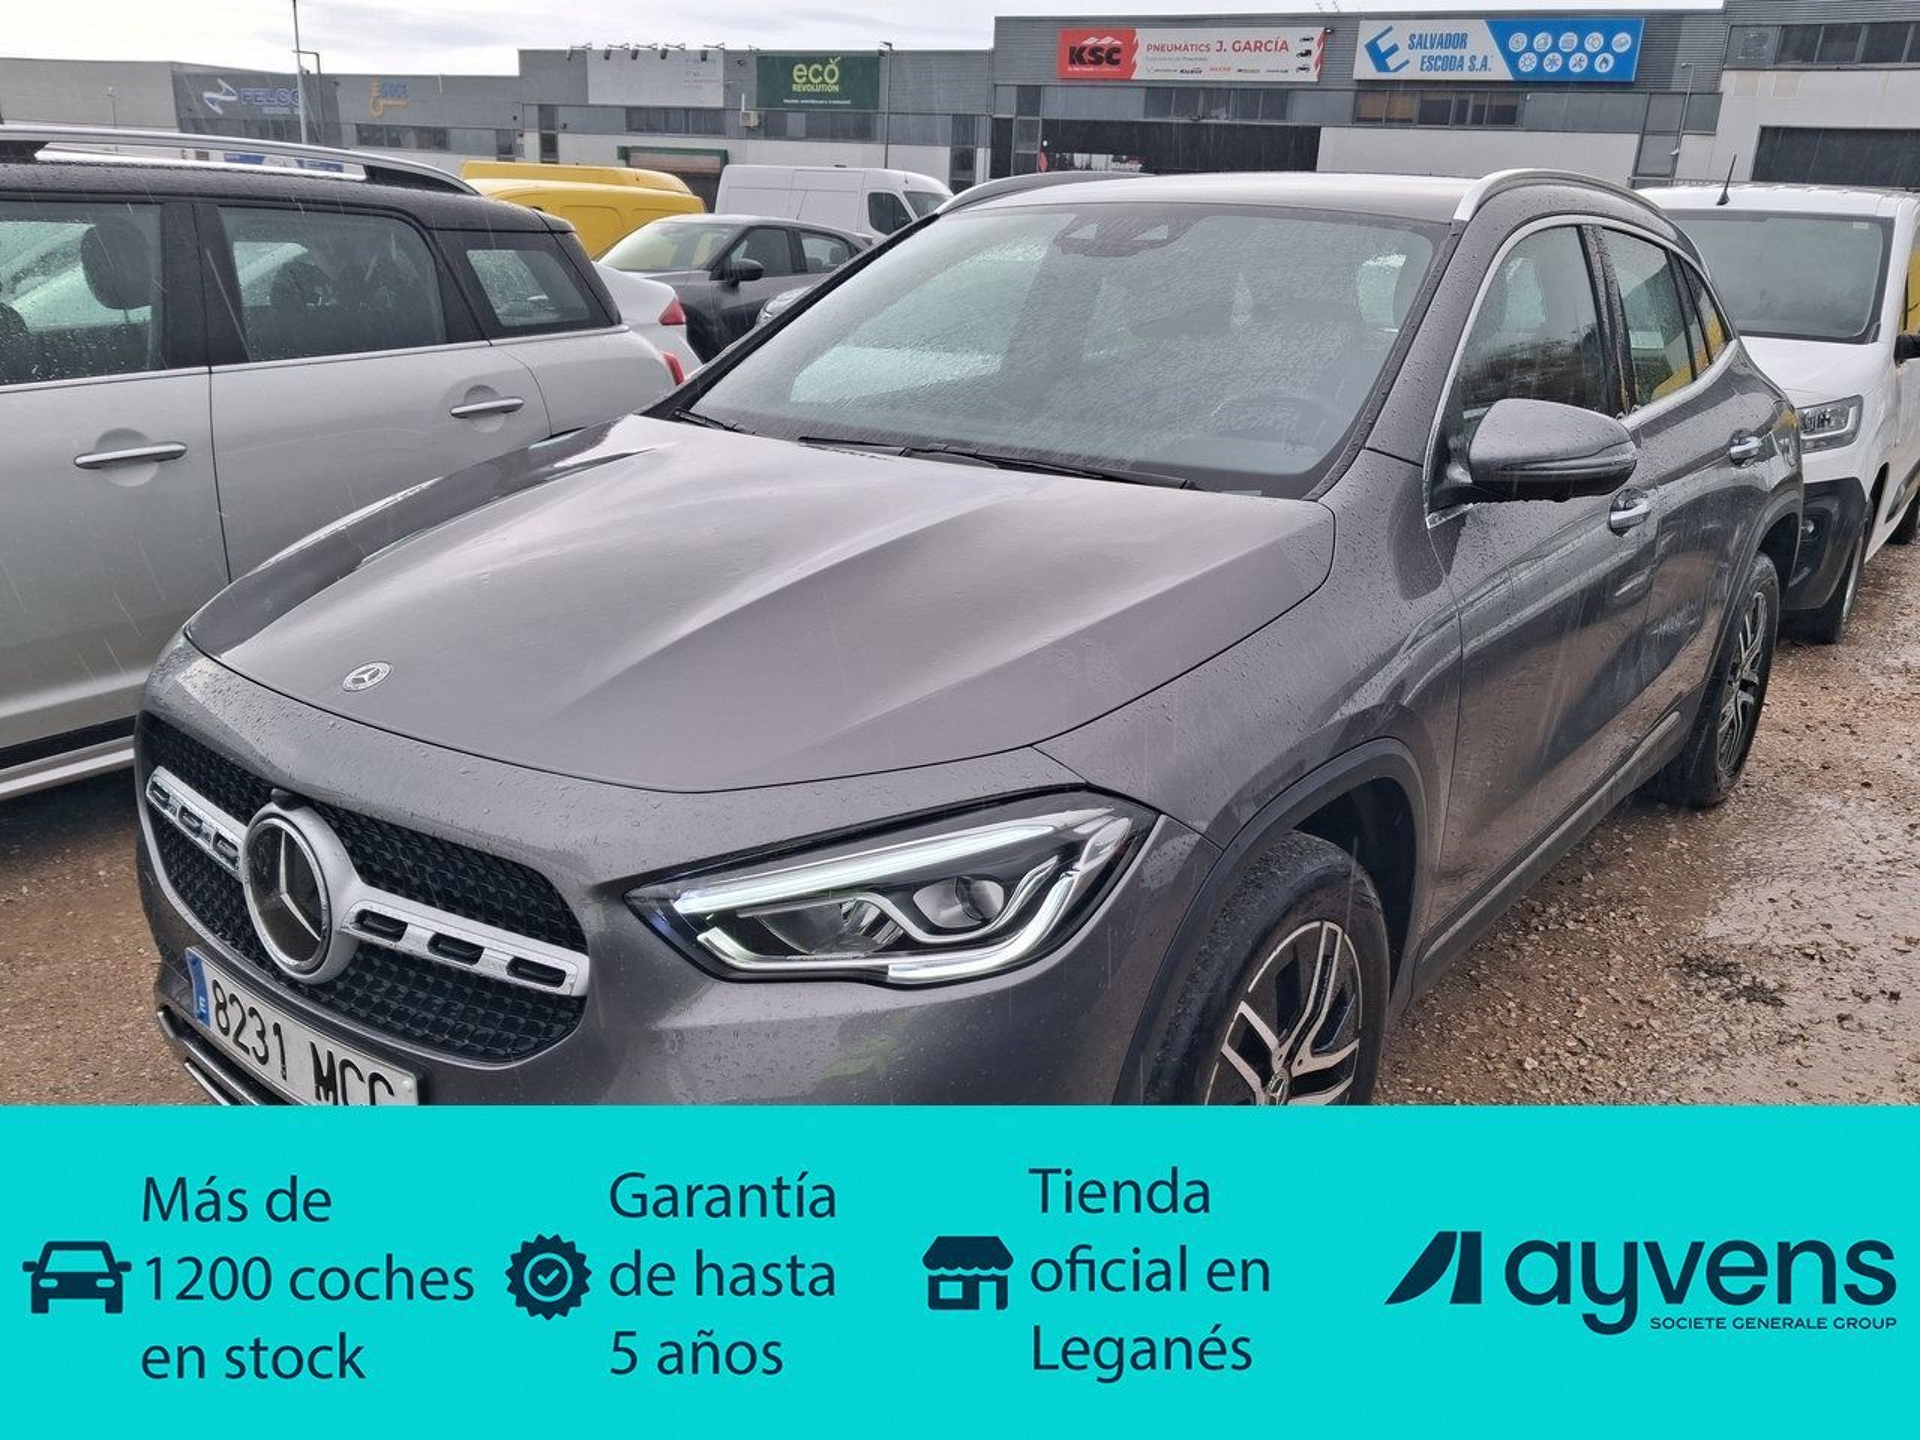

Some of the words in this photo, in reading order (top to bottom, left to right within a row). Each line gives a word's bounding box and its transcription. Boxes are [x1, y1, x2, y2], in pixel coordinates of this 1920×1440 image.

[1146, 43, 1211, 53] PNEUMATICS
[1216, 40, 1227, 52] J.
[1232, 36, 1289, 53] GARCÍA
[1408, 32, 1468, 50] SALVADOR
[1068, 46, 1122, 65] KSC
[1420, 55, 1464, 72] ESCODA
[1468, 55, 1492, 72] S.A.
[792, 60, 840, 84] eco
[792, 84, 840, 93] REVOLUTION
[198, 995, 208, 1015] E
[212, 979, 288, 1082] 8231
